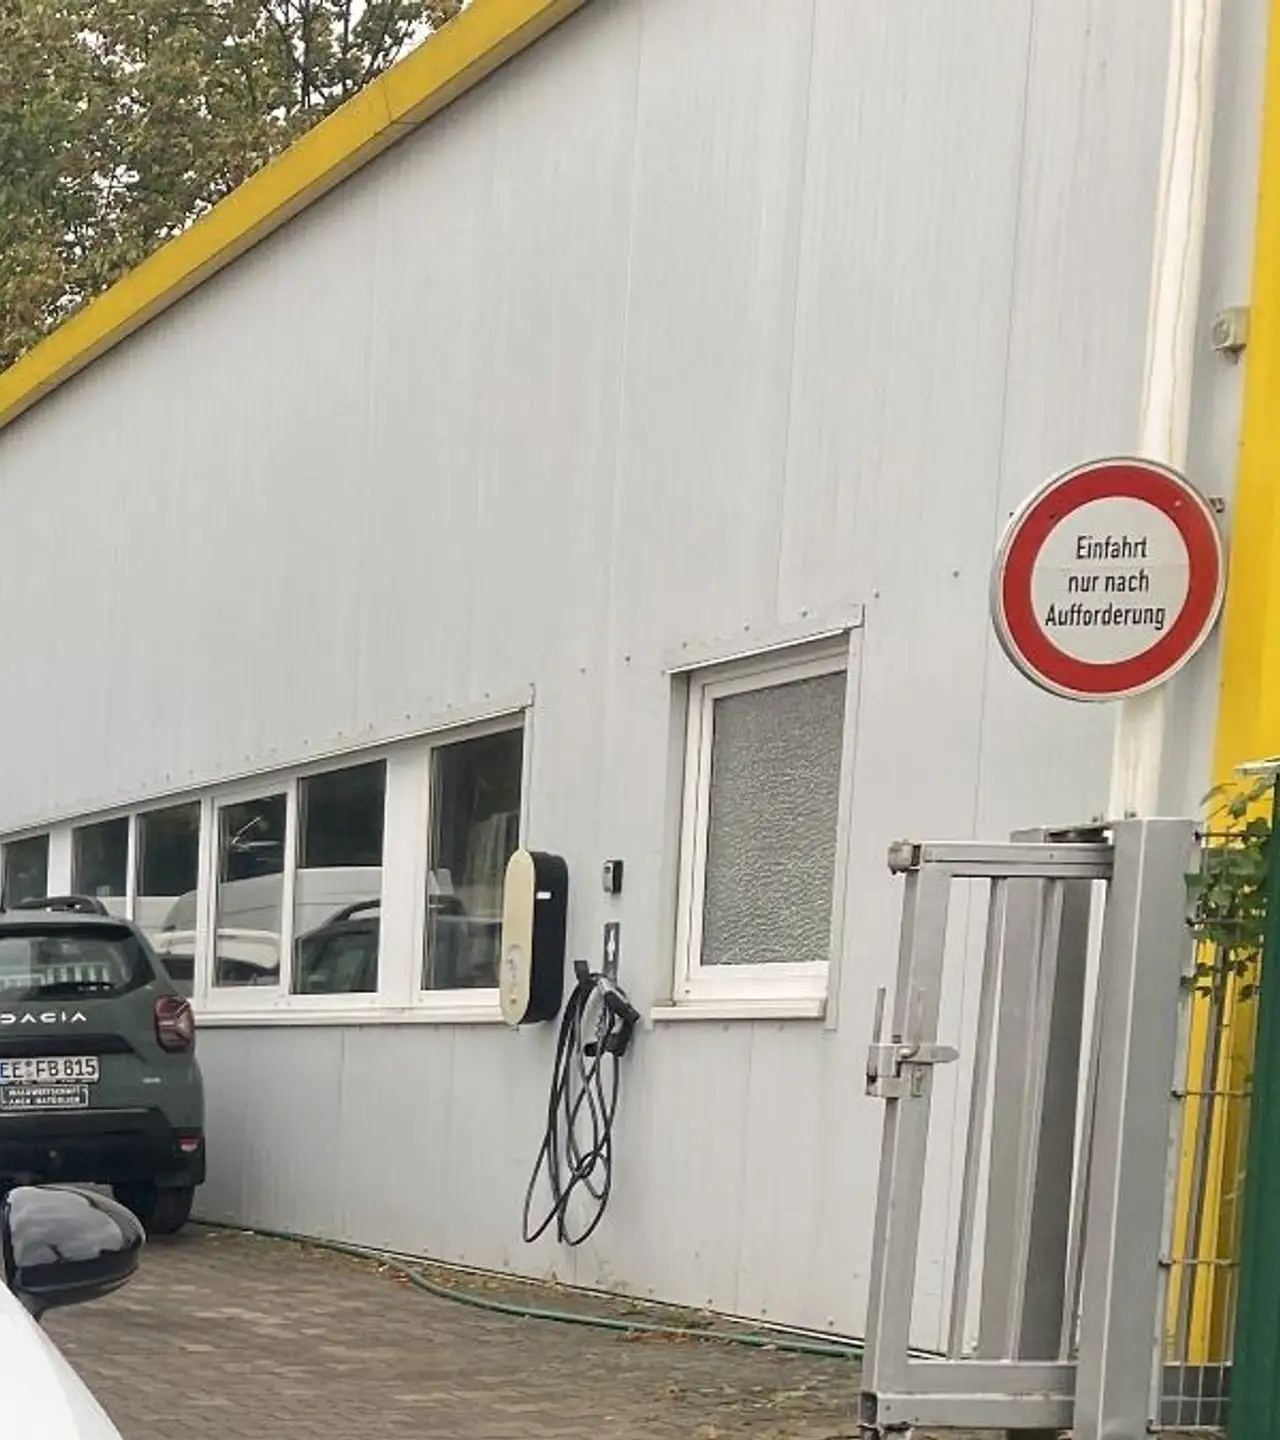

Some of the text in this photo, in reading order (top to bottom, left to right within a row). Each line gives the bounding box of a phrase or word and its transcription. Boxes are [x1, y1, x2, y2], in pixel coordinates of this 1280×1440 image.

[1076, 535, 1147, 560] Einfahrt
[1068, 568, 1149, 592] nur nach
[1045, 602, 1166, 630] Aufforderung
[0, 1011, 87, 1024] DACIA
